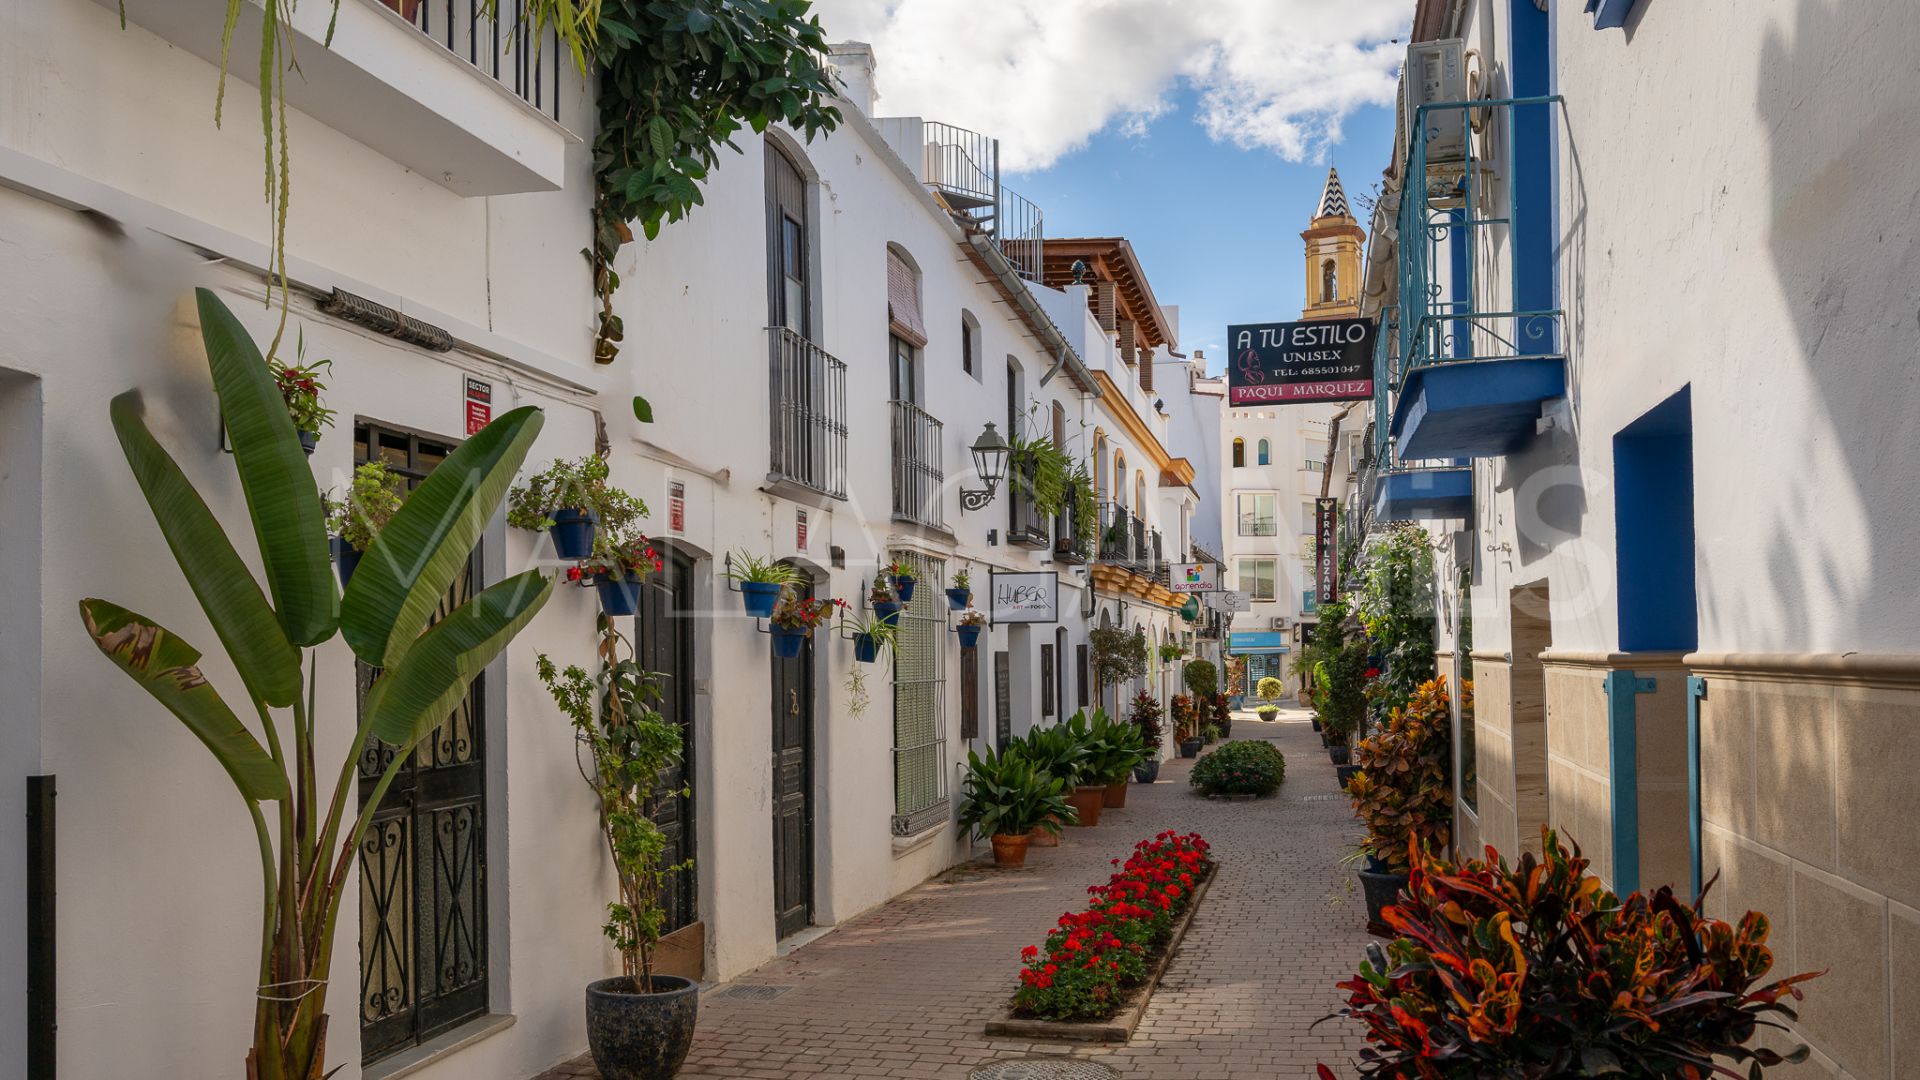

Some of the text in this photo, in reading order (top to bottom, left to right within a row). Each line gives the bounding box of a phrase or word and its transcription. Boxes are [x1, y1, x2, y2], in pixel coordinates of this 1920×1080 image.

[1237, 323, 1366, 349] A TU ESTILO
[1283, 350, 1342, 362] UNISEX
[1301, 365, 1361, 375] 685501047
[468, 380, 490, 393] SECTOR
[1238, 382, 1366, 399] PAQUI MARQUEZ
[1323, 512, 1331, 600] FRAN LOZANO
[1175, 581, 1213, 590] aprendia
[997, 583, 1052, 609] HUBER
